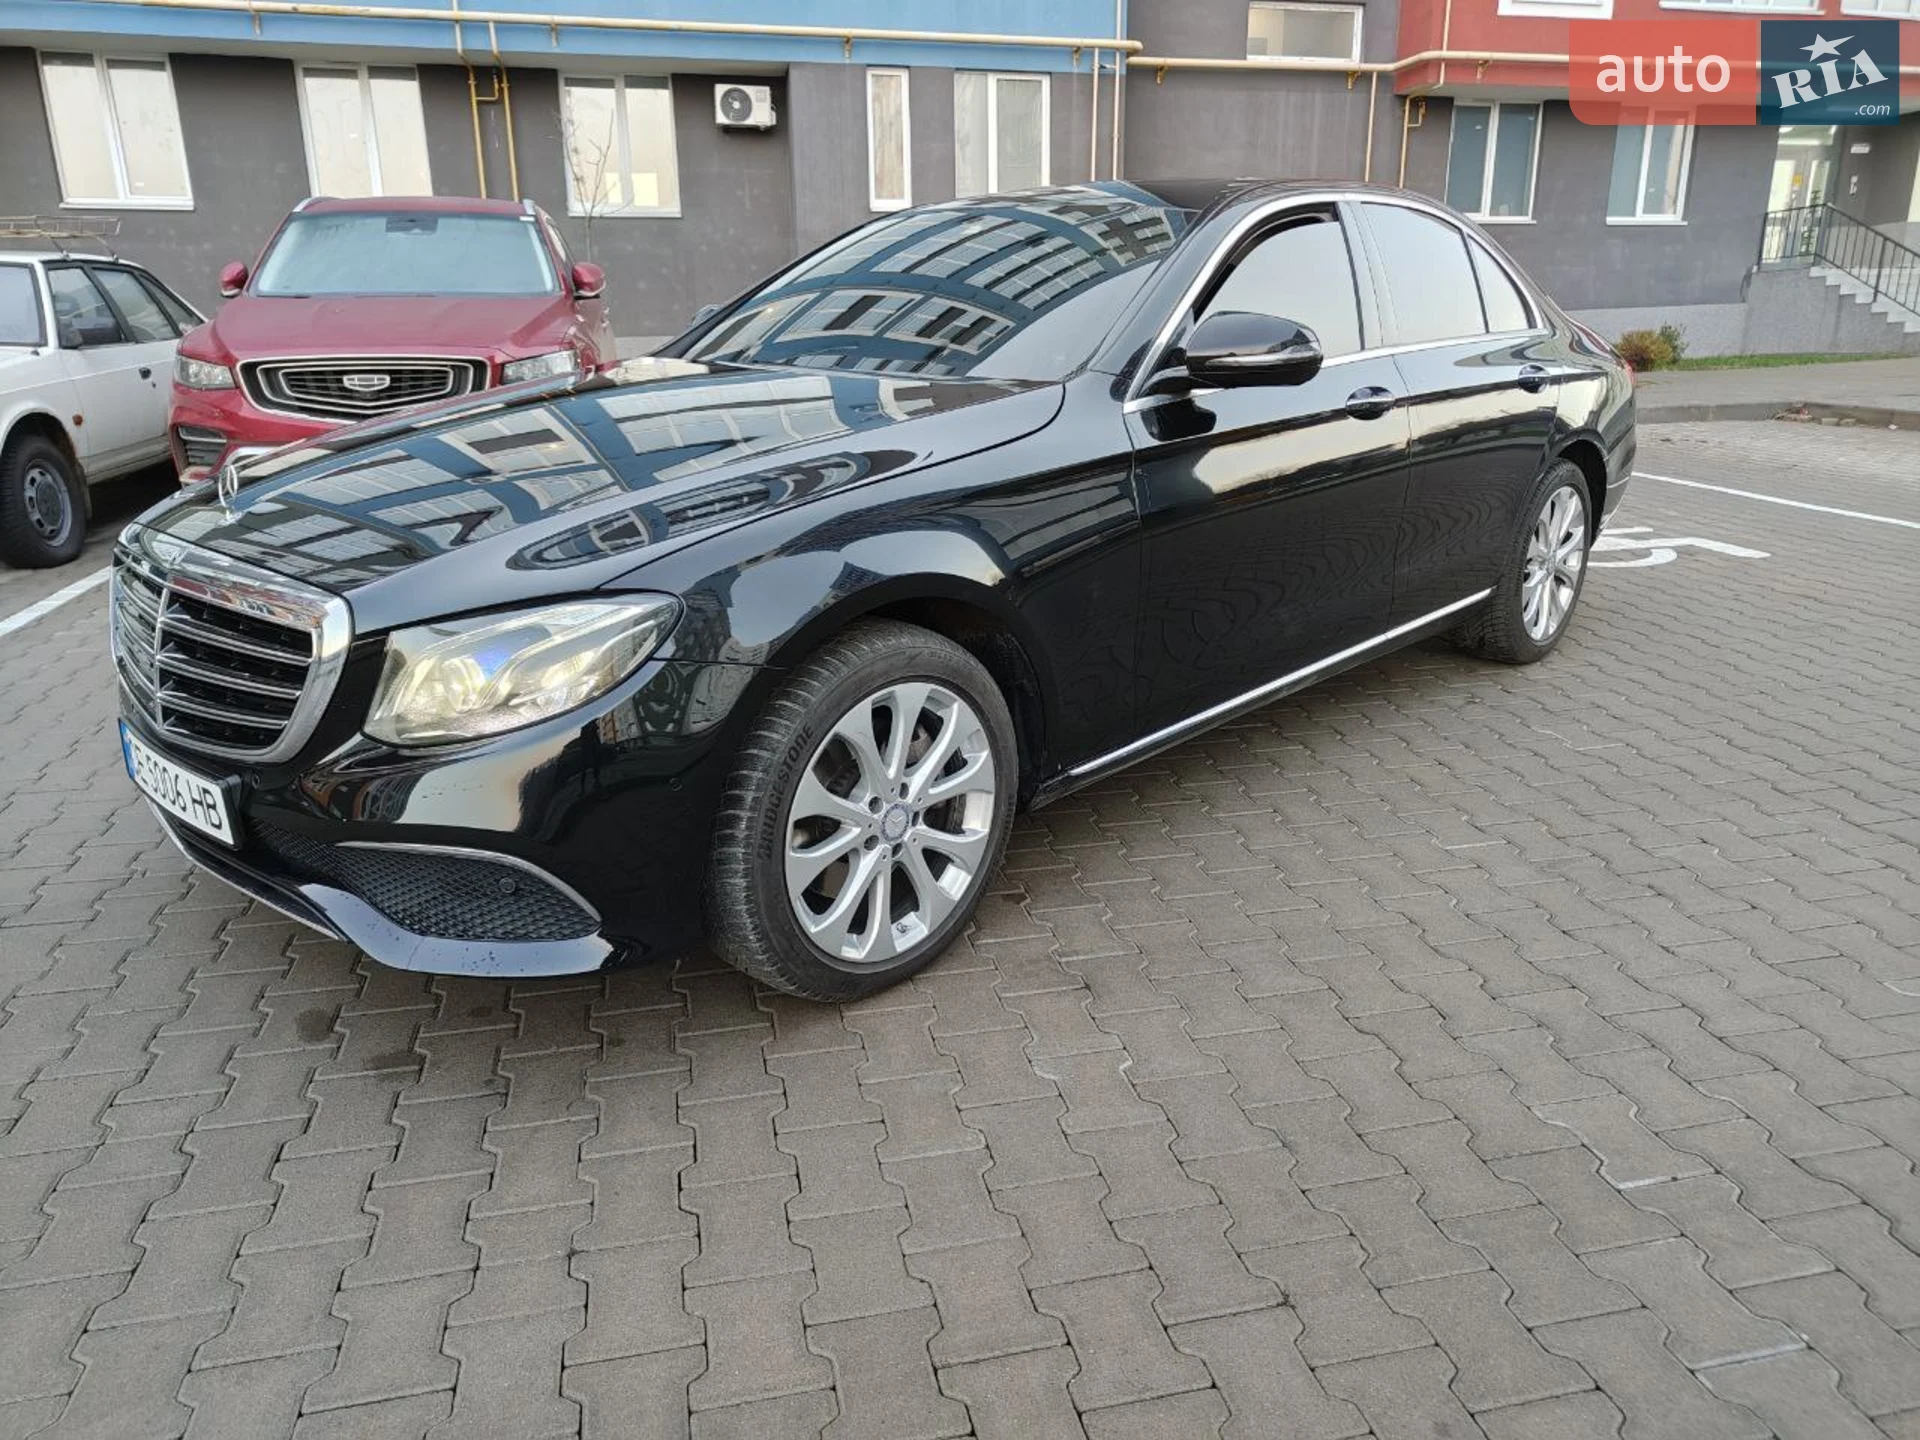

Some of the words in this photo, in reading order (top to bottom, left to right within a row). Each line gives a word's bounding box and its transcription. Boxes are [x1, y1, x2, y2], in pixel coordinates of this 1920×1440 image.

[146, 754, 187, 813] 5006
[186, 779, 223, 831] HB
[757, 722, 815, 861] BRIDGESTONE
